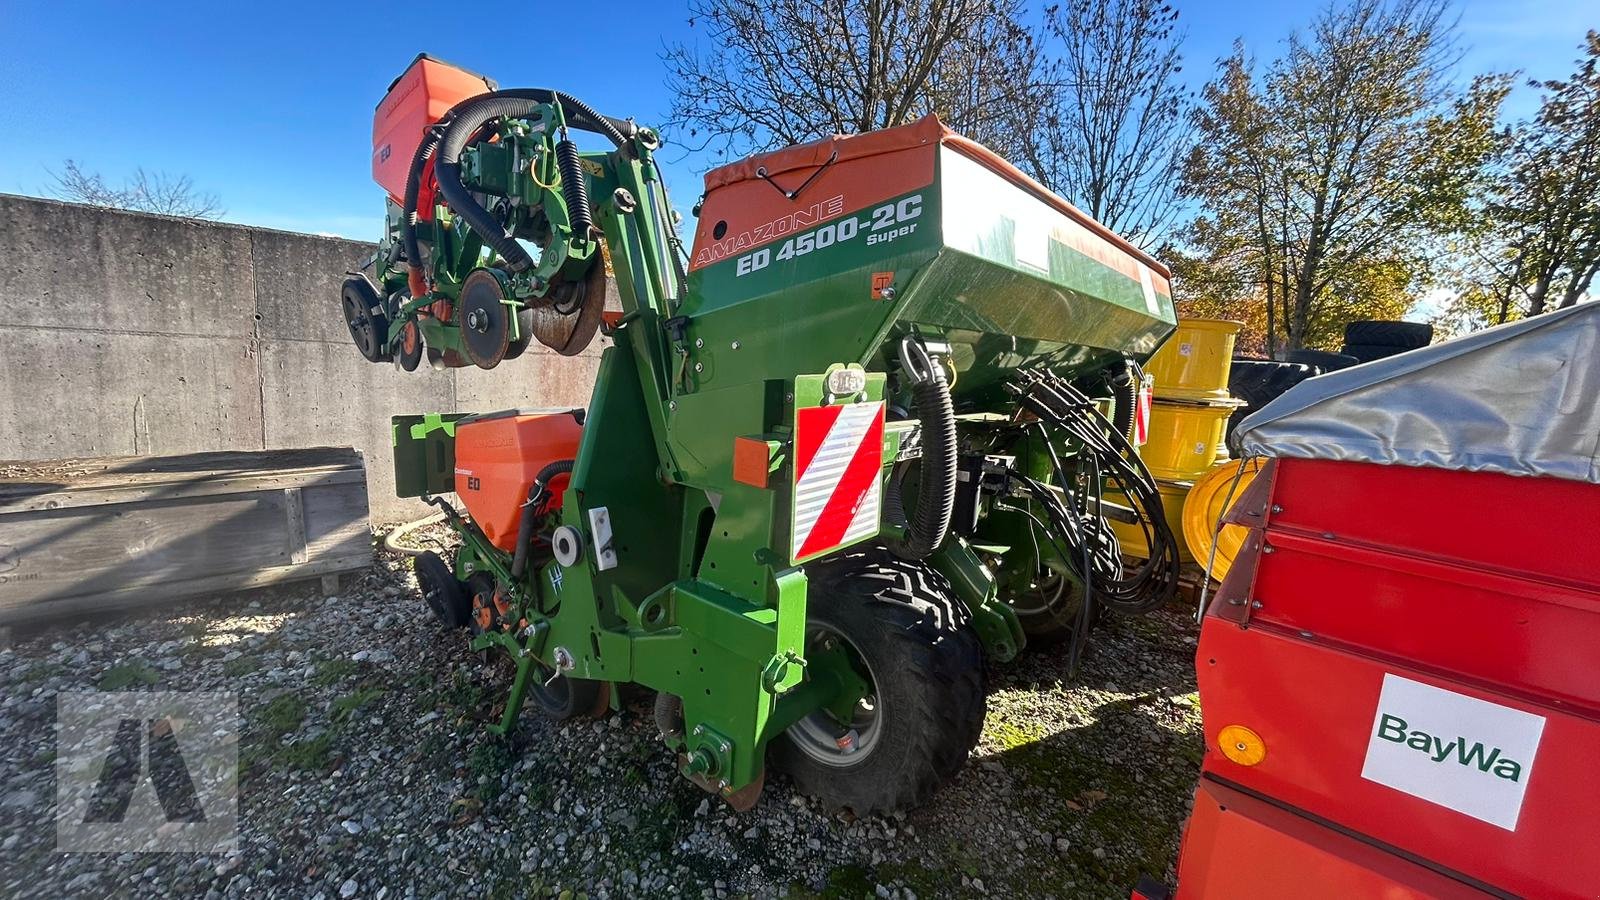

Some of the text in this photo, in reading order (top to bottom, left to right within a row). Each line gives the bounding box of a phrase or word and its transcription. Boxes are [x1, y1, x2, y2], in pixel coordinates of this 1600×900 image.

[694, 195, 843, 266] AMAZONE
[736, 194, 923, 277] ED 4500-2C
[866, 222, 918, 246] Super
[467, 476, 480, 490] ED
[1377, 713, 1521, 782] BayWa
